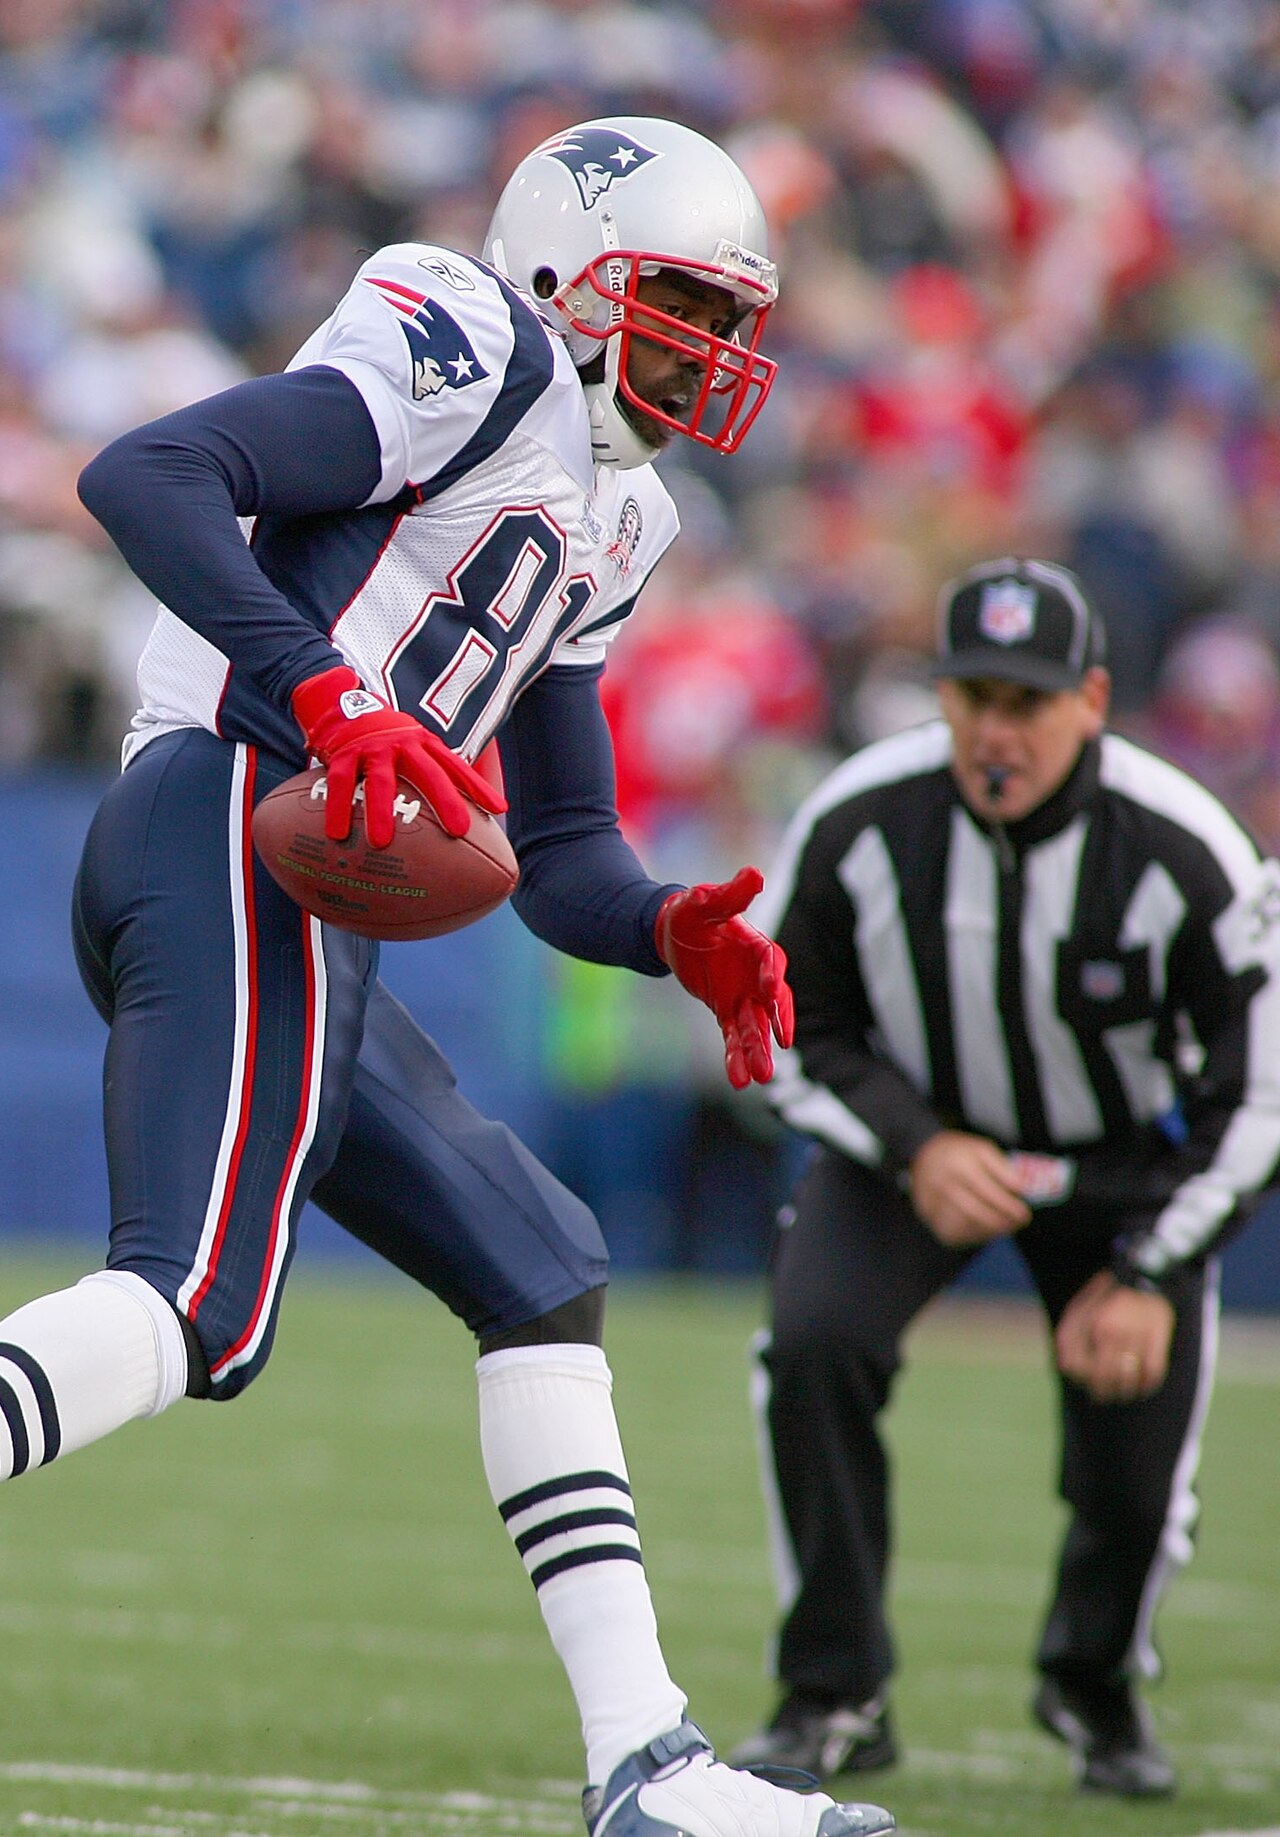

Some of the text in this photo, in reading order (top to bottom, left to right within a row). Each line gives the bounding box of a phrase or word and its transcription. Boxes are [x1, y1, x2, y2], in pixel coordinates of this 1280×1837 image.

[609, 265, 623, 322] Ridell
[382, 505, 598, 757] 81
[319, 871, 377, 892] FOOTBALL
[380, 884, 429, 898] LEAGUE
